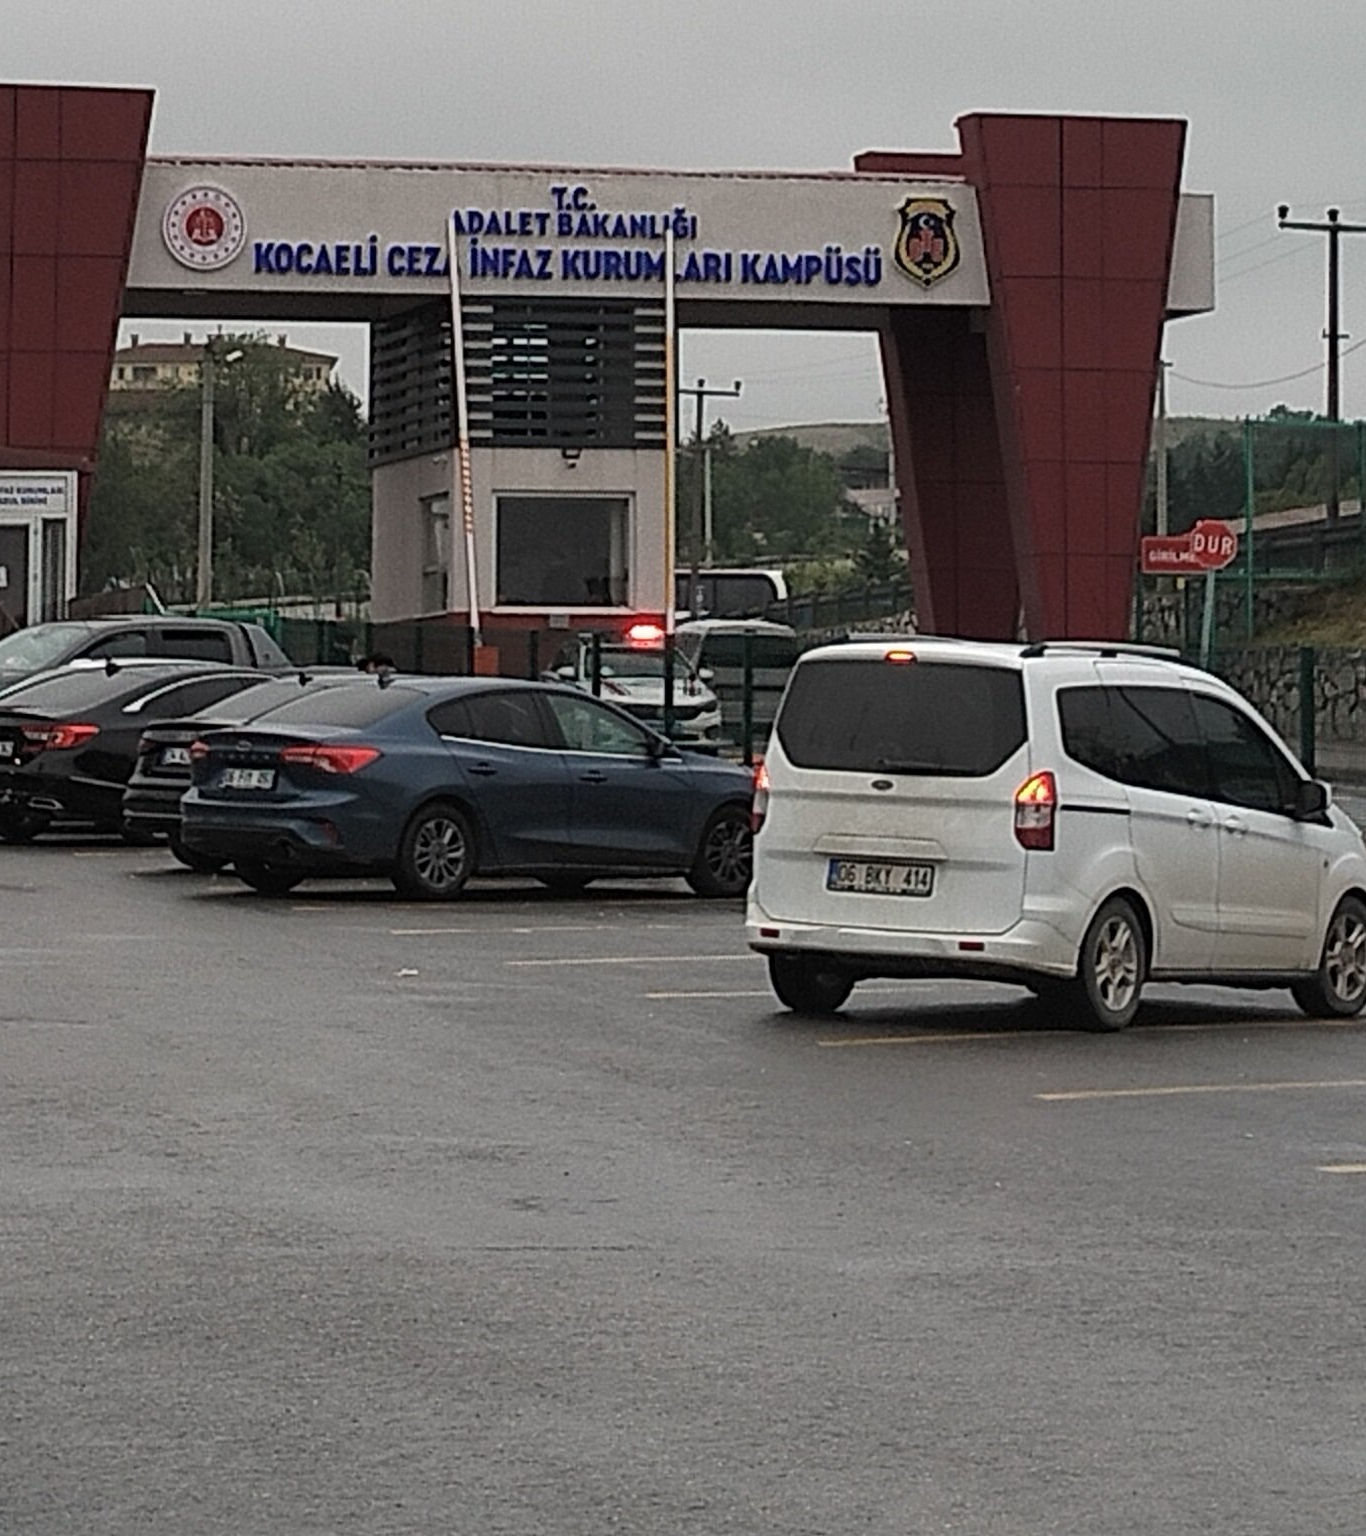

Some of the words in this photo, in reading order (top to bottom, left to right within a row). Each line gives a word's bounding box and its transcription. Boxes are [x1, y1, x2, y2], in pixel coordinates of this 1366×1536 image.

[551, 186, 597, 211] T.C.
[453, 210, 550, 236] ADALET
[254, 234, 377, 276] KOCAELİ
[470, 238, 553, 280] İNFAZ
[741, 246, 882, 286] KAMPÜSÜ
[1194, 533, 1233, 555] DUR
